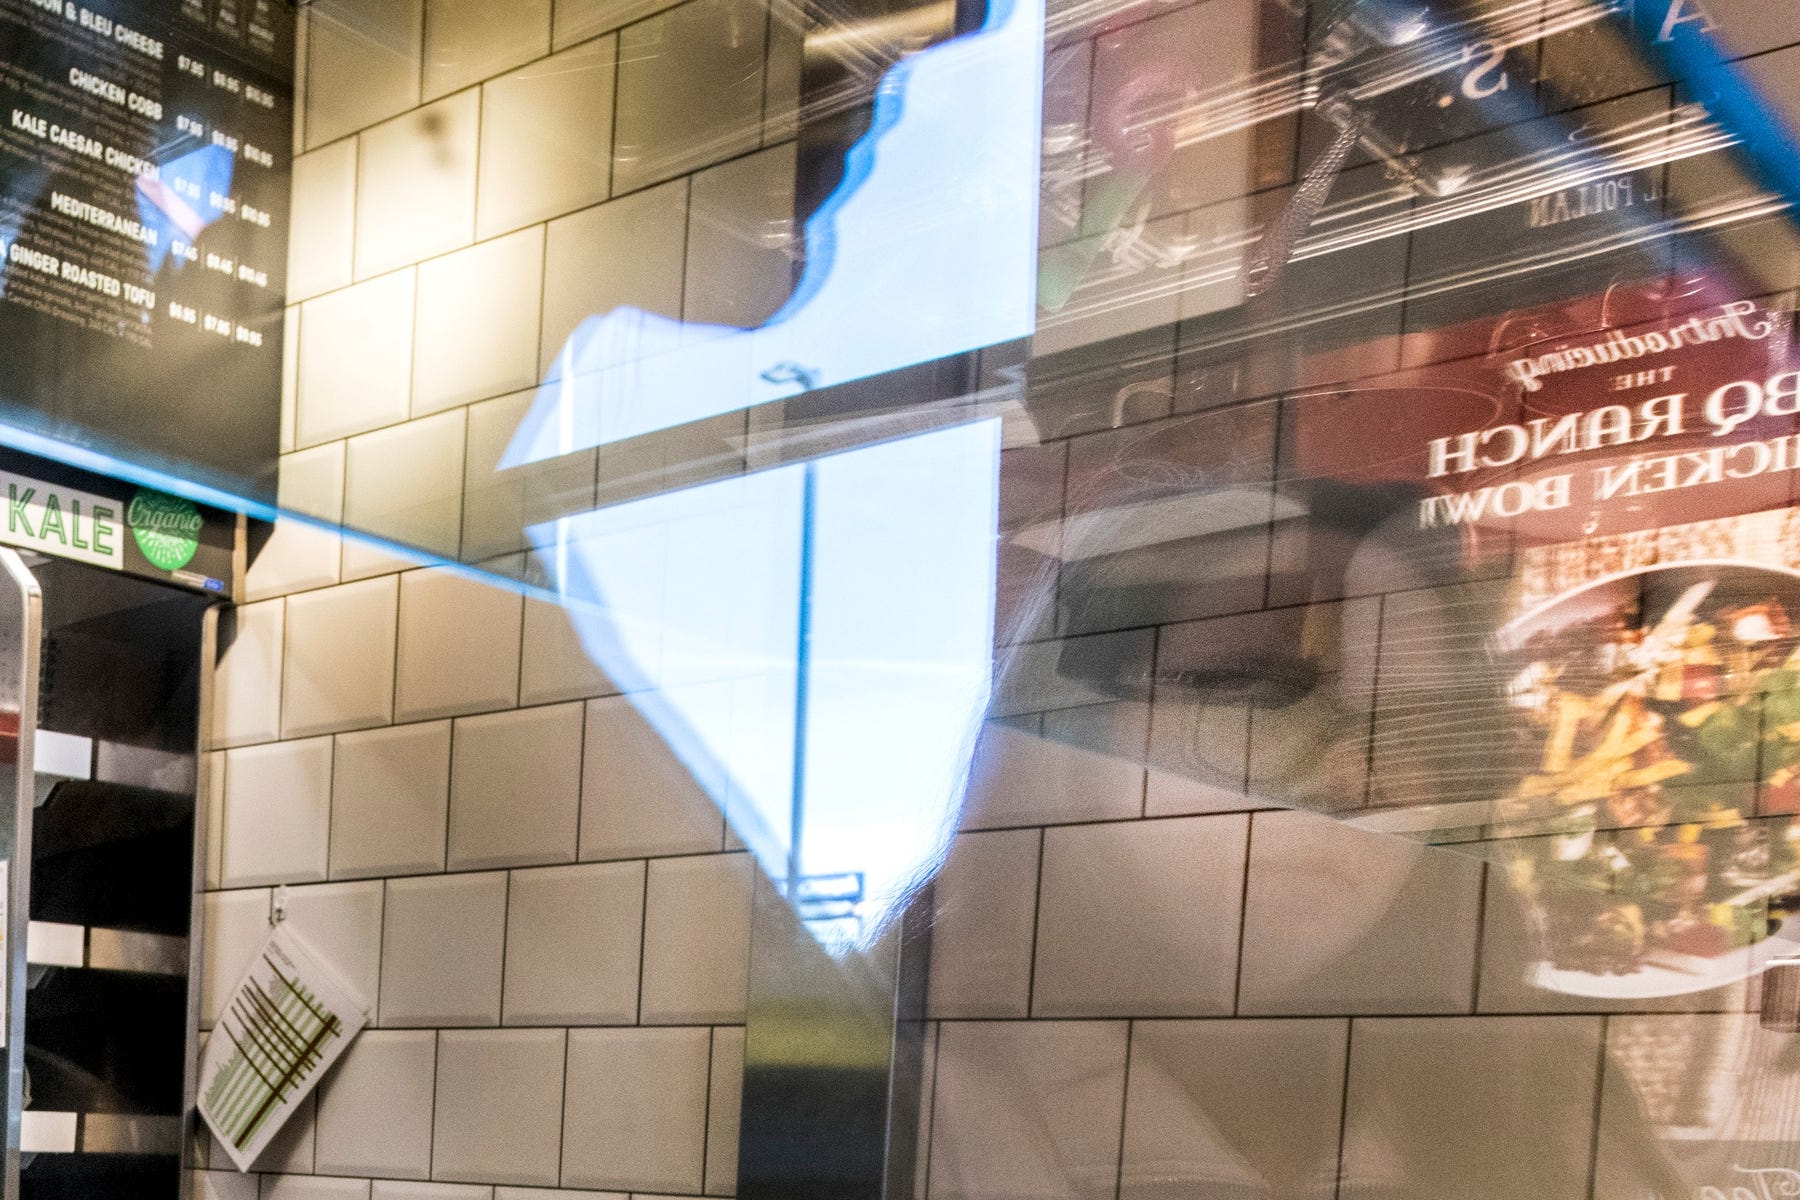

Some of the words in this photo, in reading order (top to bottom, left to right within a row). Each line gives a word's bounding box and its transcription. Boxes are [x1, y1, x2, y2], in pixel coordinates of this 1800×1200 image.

[66, 2, 77, 21] &
[80, 8, 112, 37] BLEU
[114, 24, 164, 59] CHEESE
[69, 67, 126, 106] CHICKEN
[128, 92, 163, 121] COBB
[12, 109, 47, 139] KALE
[50, 124, 103, 160] CAESAR
[105, 146, 160, 179] CHICKEN
[51, 191, 157, 246] MEDITERRANEAN
[10, 243, 59, 275] GINGER
[62, 262, 120, 297] ROASTED
[122, 283, 156, 310] TOFU
[8, 483, 116, 556] KALE
[127, 495, 204, 532] Organic
